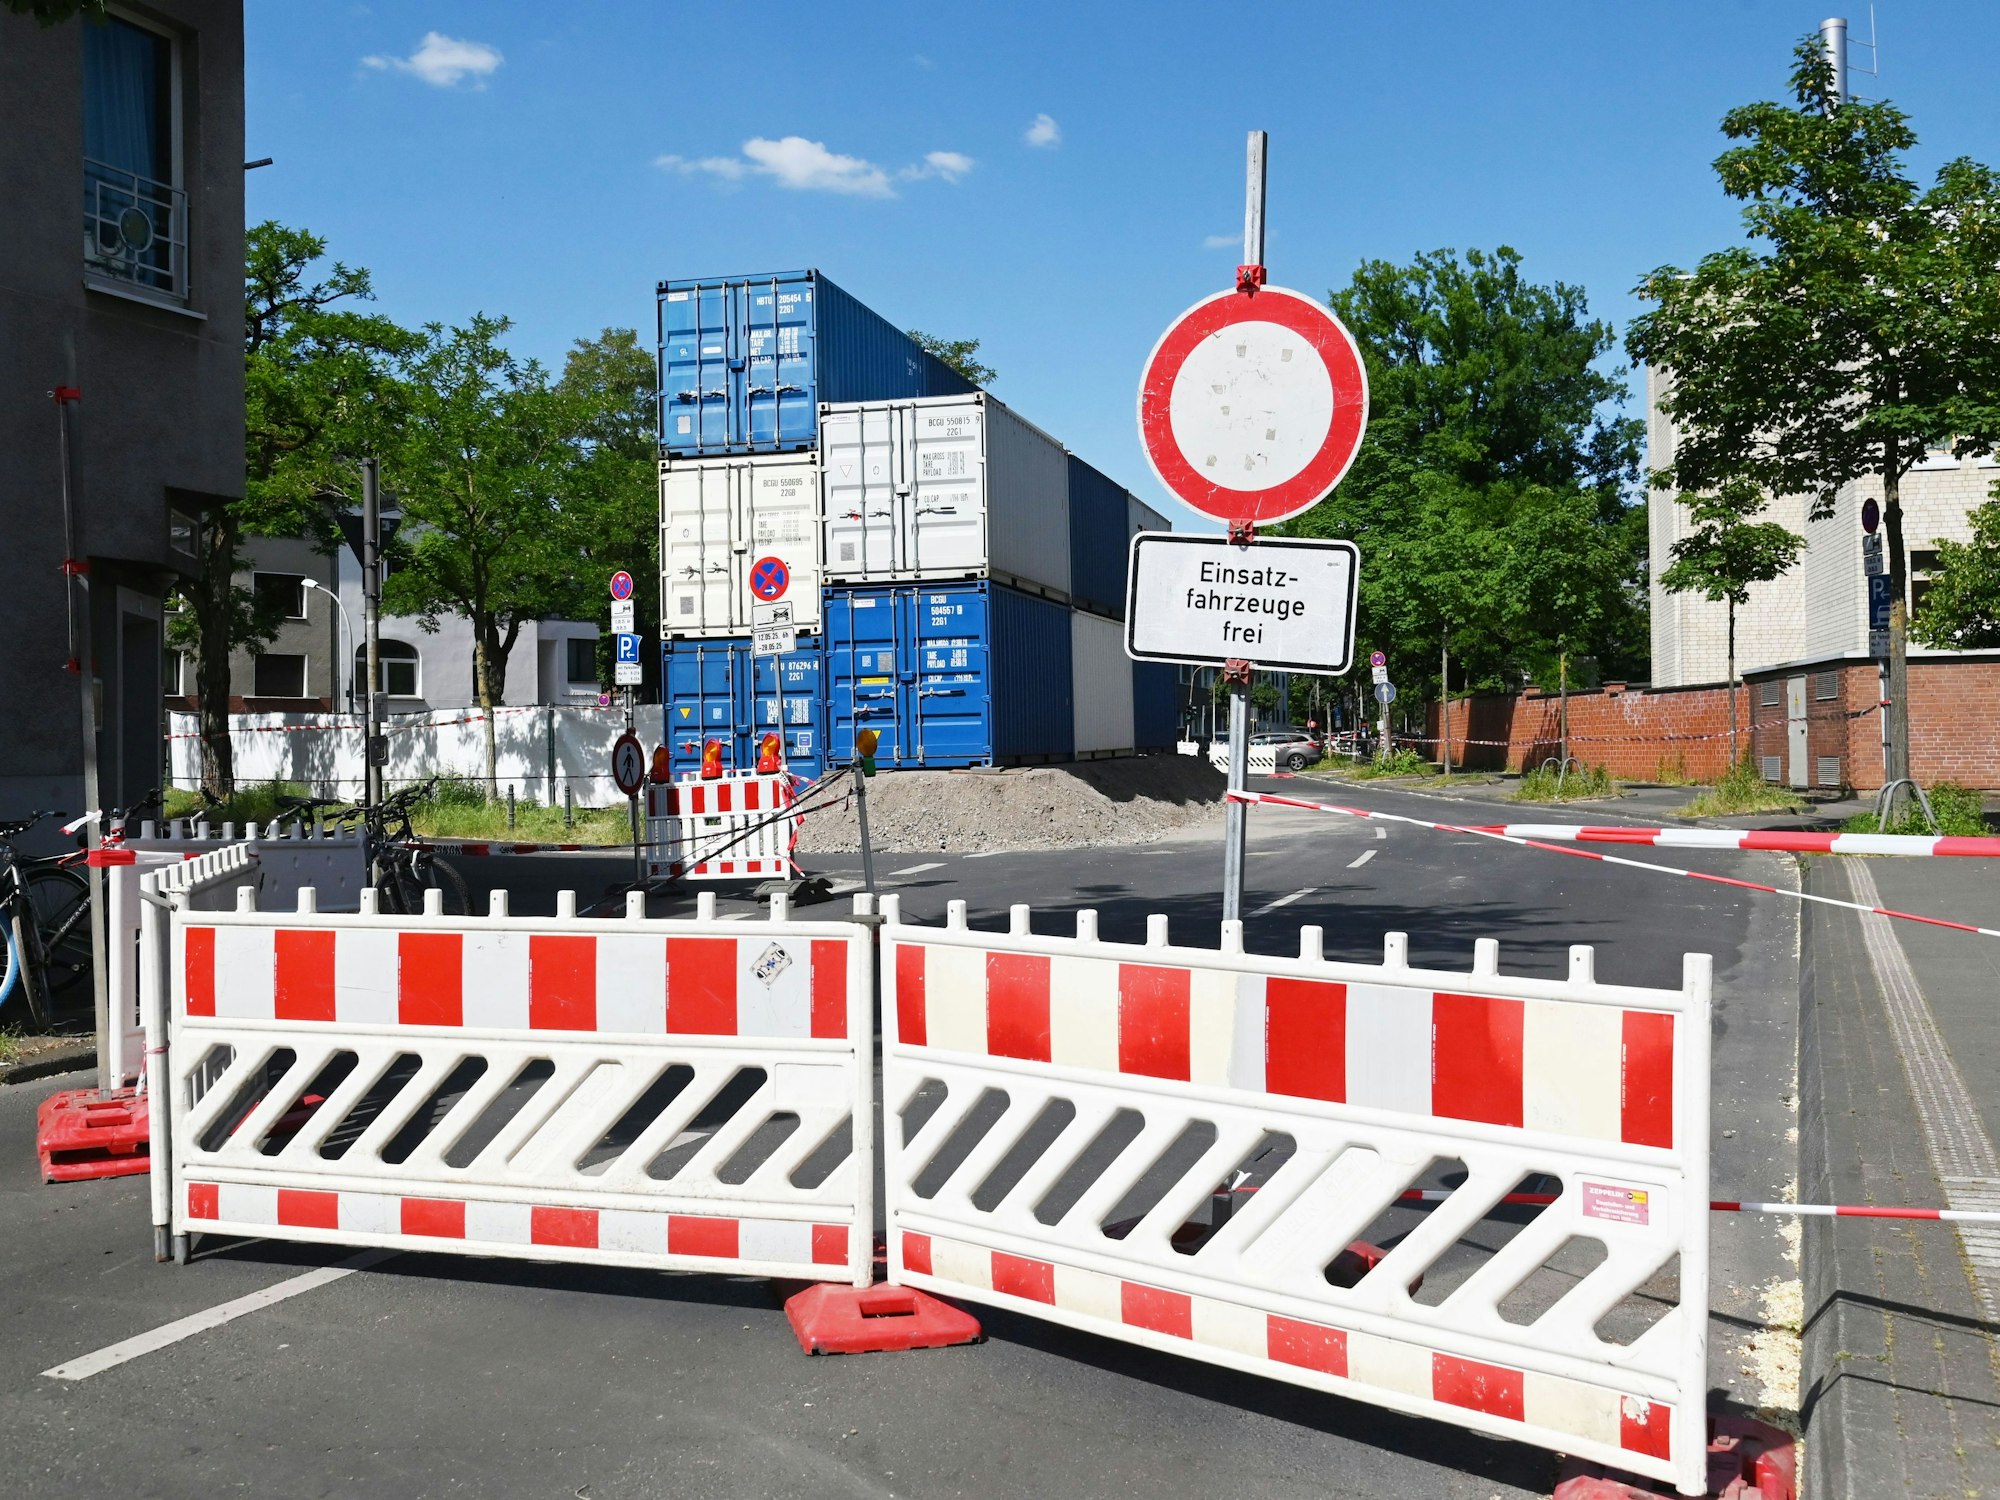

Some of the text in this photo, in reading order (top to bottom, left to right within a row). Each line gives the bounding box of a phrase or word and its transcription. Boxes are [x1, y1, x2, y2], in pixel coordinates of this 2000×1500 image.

[756, 296, 773, 306] HBTU
[779, 293, 802, 304] 205454
[750, 347, 762, 356] NET
[928, 415, 981, 427] BCGU 550815 9
[922, 460, 934, 469] TARE
[922, 468, 942, 477] PAYLOAD
[763, 477, 815, 488] BCGU 550695 8
[1200, 561, 1298, 588] Einsatz-
[1872, 579, 1884, 600] P
[930, 595, 947, 605] BCGU
[1186, 588, 1305, 621] fahrzeuge
[931, 606, 955, 616] 504557
[1223, 621, 1263, 644] frei
[620, 636, 632, 659] P
[788, 661, 811, 671] 876296
[813, 660, 819, 671] 4
[1589, 1186, 1625, 1199] ZEPPELIN
